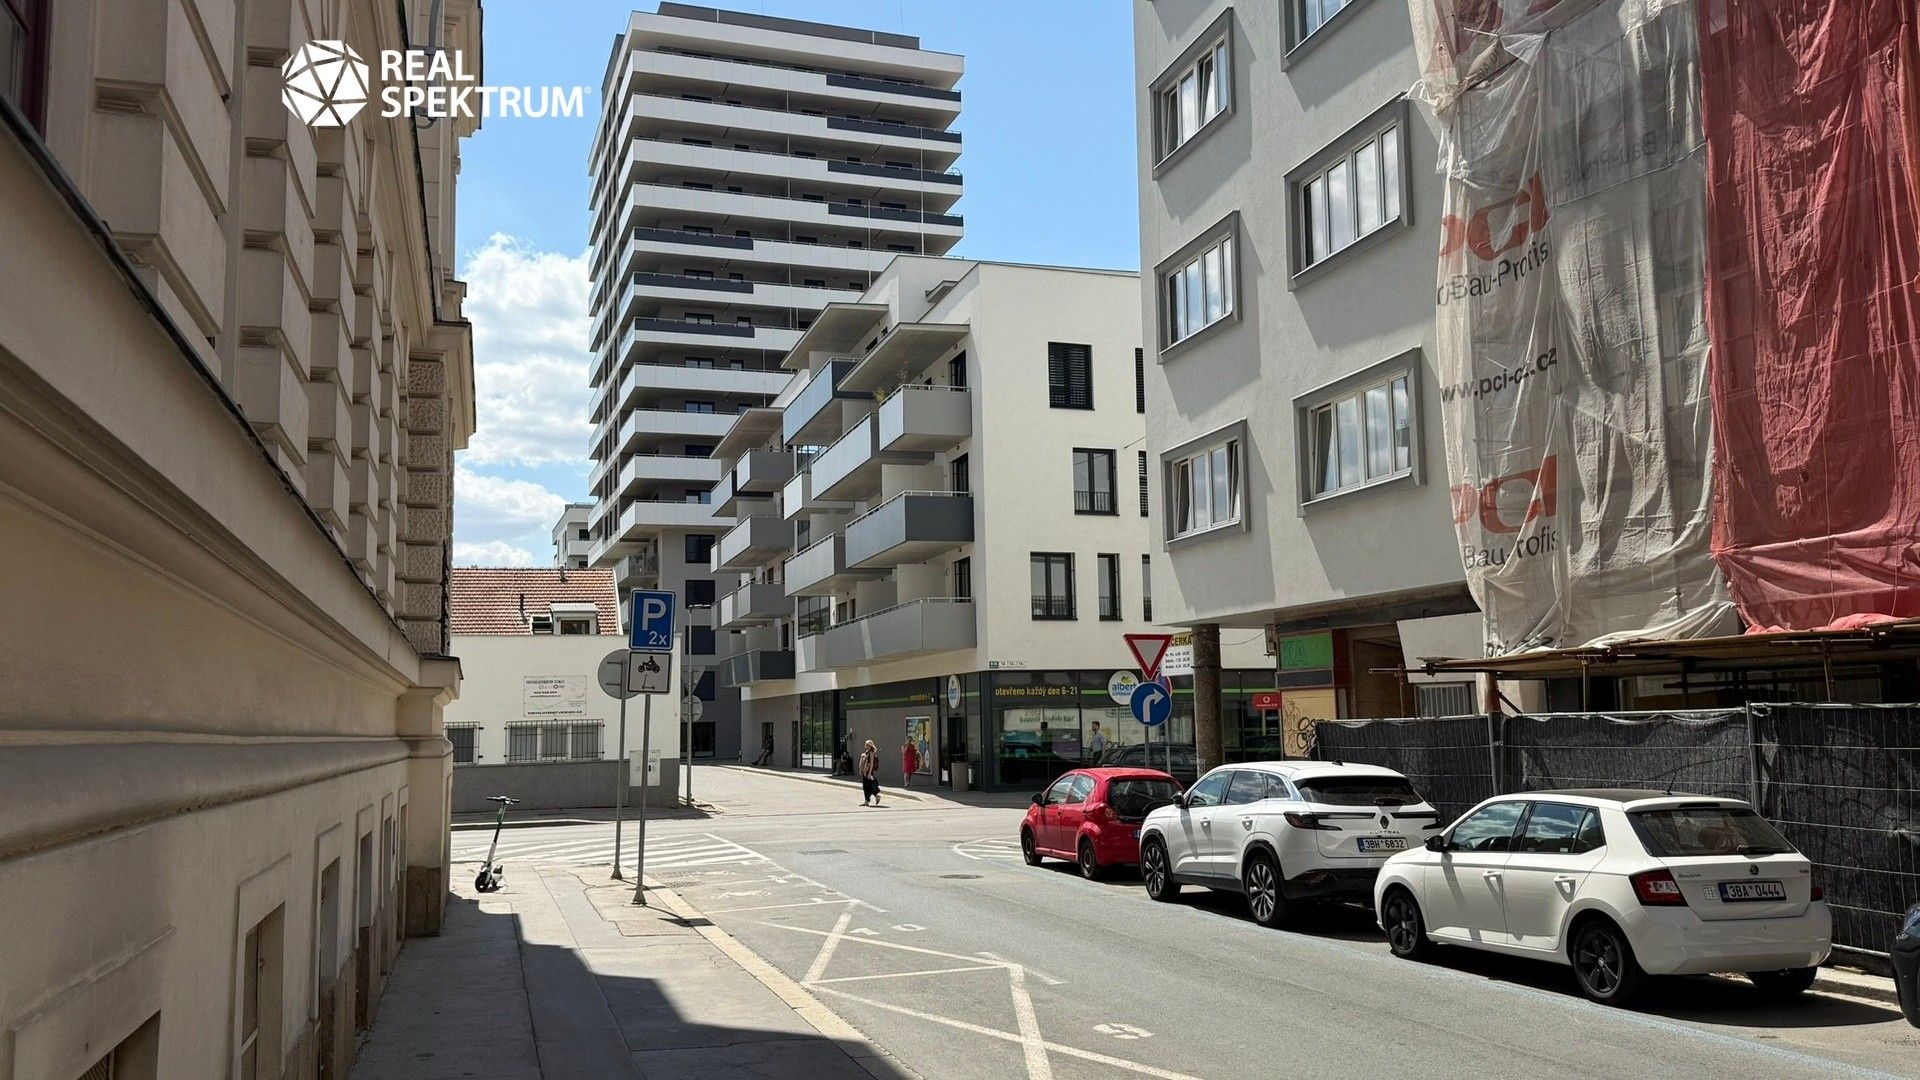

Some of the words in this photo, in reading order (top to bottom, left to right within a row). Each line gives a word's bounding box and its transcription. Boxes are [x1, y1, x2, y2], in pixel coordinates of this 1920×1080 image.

[642, 598, 667, 631] P
[648, 630, 668, 646] 2x
[995, 687, 1025, 696] otevřeno
[1026, 686, 1047, 697] každý
[1048, 687, 1060, 695] den
[1385, 840, 1405, 849] 6832
[1729, 884, 1749, 898] 3BA
[1755, 883, 1781, 897] 0444
